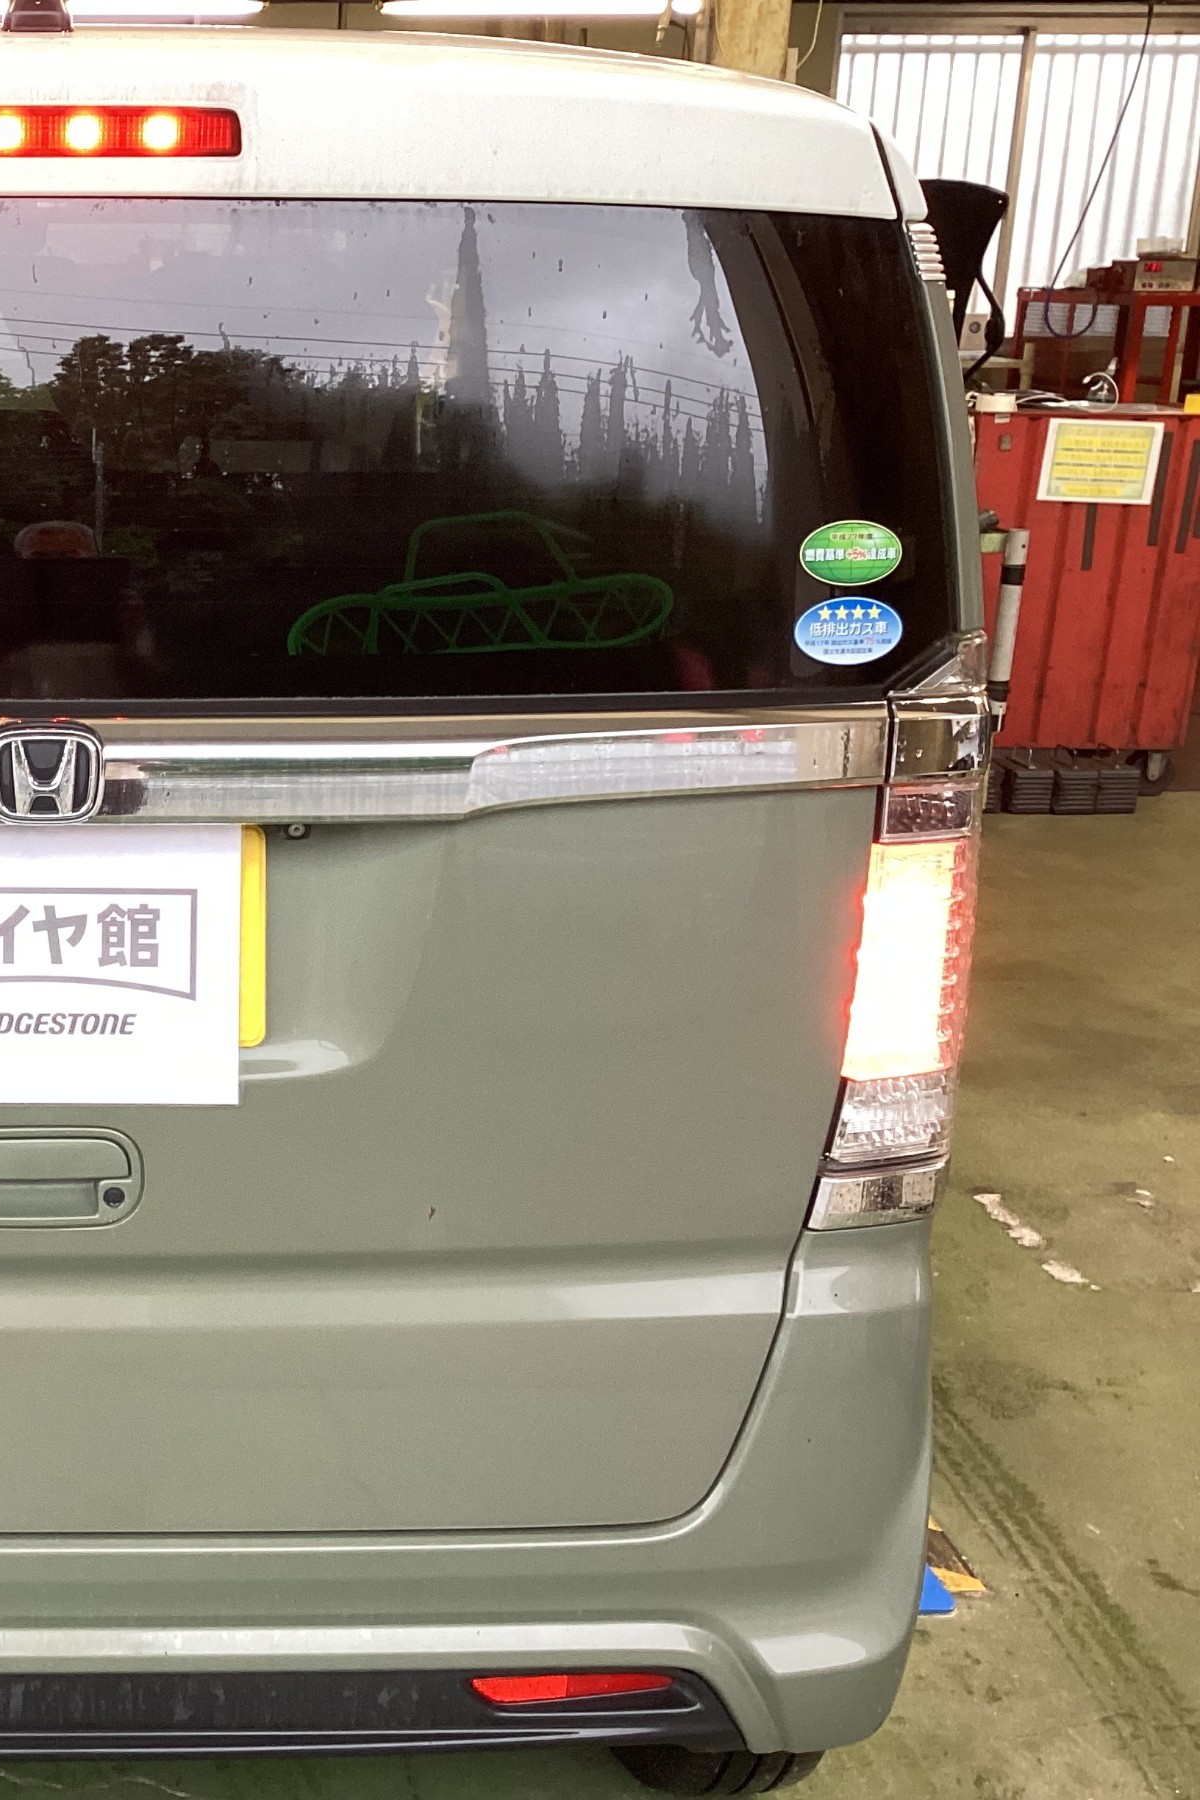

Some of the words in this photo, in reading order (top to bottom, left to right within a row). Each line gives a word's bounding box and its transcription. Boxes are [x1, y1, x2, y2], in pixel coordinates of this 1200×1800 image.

[810, 621, 888, 637] 低排出ガス車
